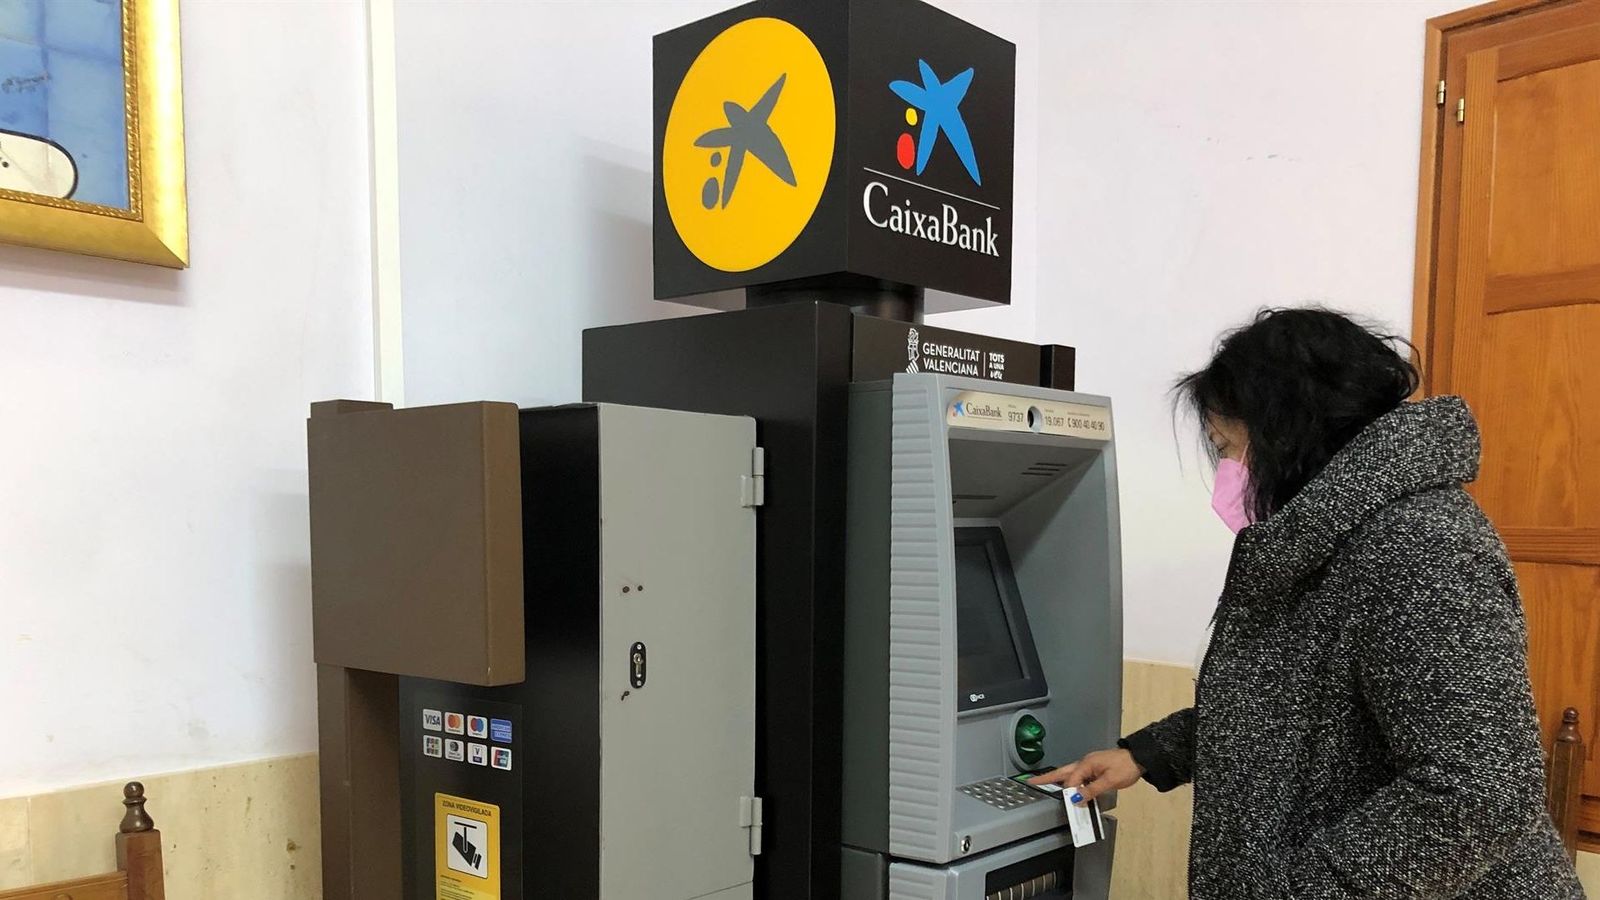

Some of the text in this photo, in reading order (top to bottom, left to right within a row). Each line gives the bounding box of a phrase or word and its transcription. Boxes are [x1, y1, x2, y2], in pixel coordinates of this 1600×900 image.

[863, 181, 1000, 257] CaixaBank
[922, 342, 980, 362] GENERALITAT
[989, 352, 1005, 363] TOTS
[923, 358, 979, 377] VALENCIANA
[966, 402, 1002, 418] CaixaBank
[1007, 411, 1024, 423] 9737
[424, 714, 441, 726] VISA
